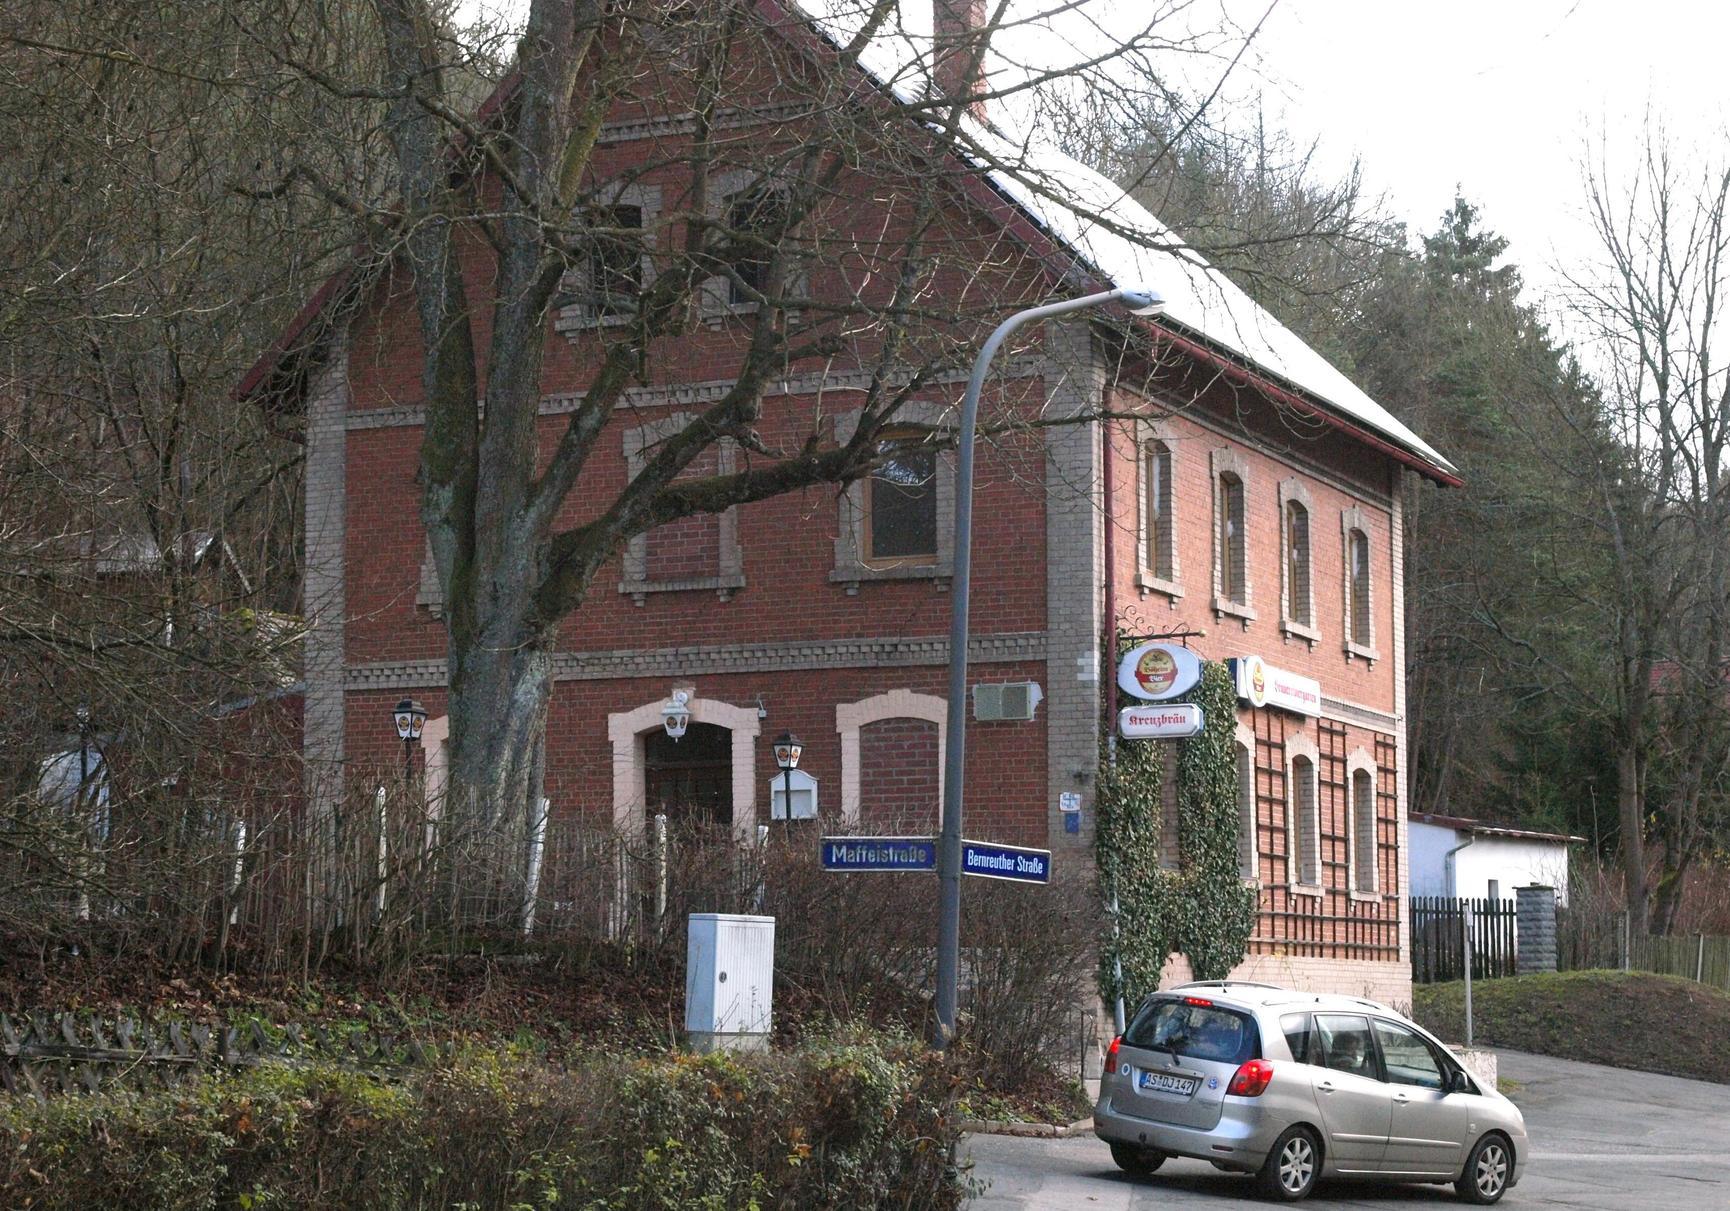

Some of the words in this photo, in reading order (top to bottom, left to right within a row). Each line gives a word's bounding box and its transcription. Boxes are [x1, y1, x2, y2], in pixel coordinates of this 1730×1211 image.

[1129, 713, 1186, 728] Kreuzbräu
[831, 845, 927, 863] Maffeistraße
[967, 849, 1015, 871] Bernreuther
[1016, 855, 1043, 874] Straße
